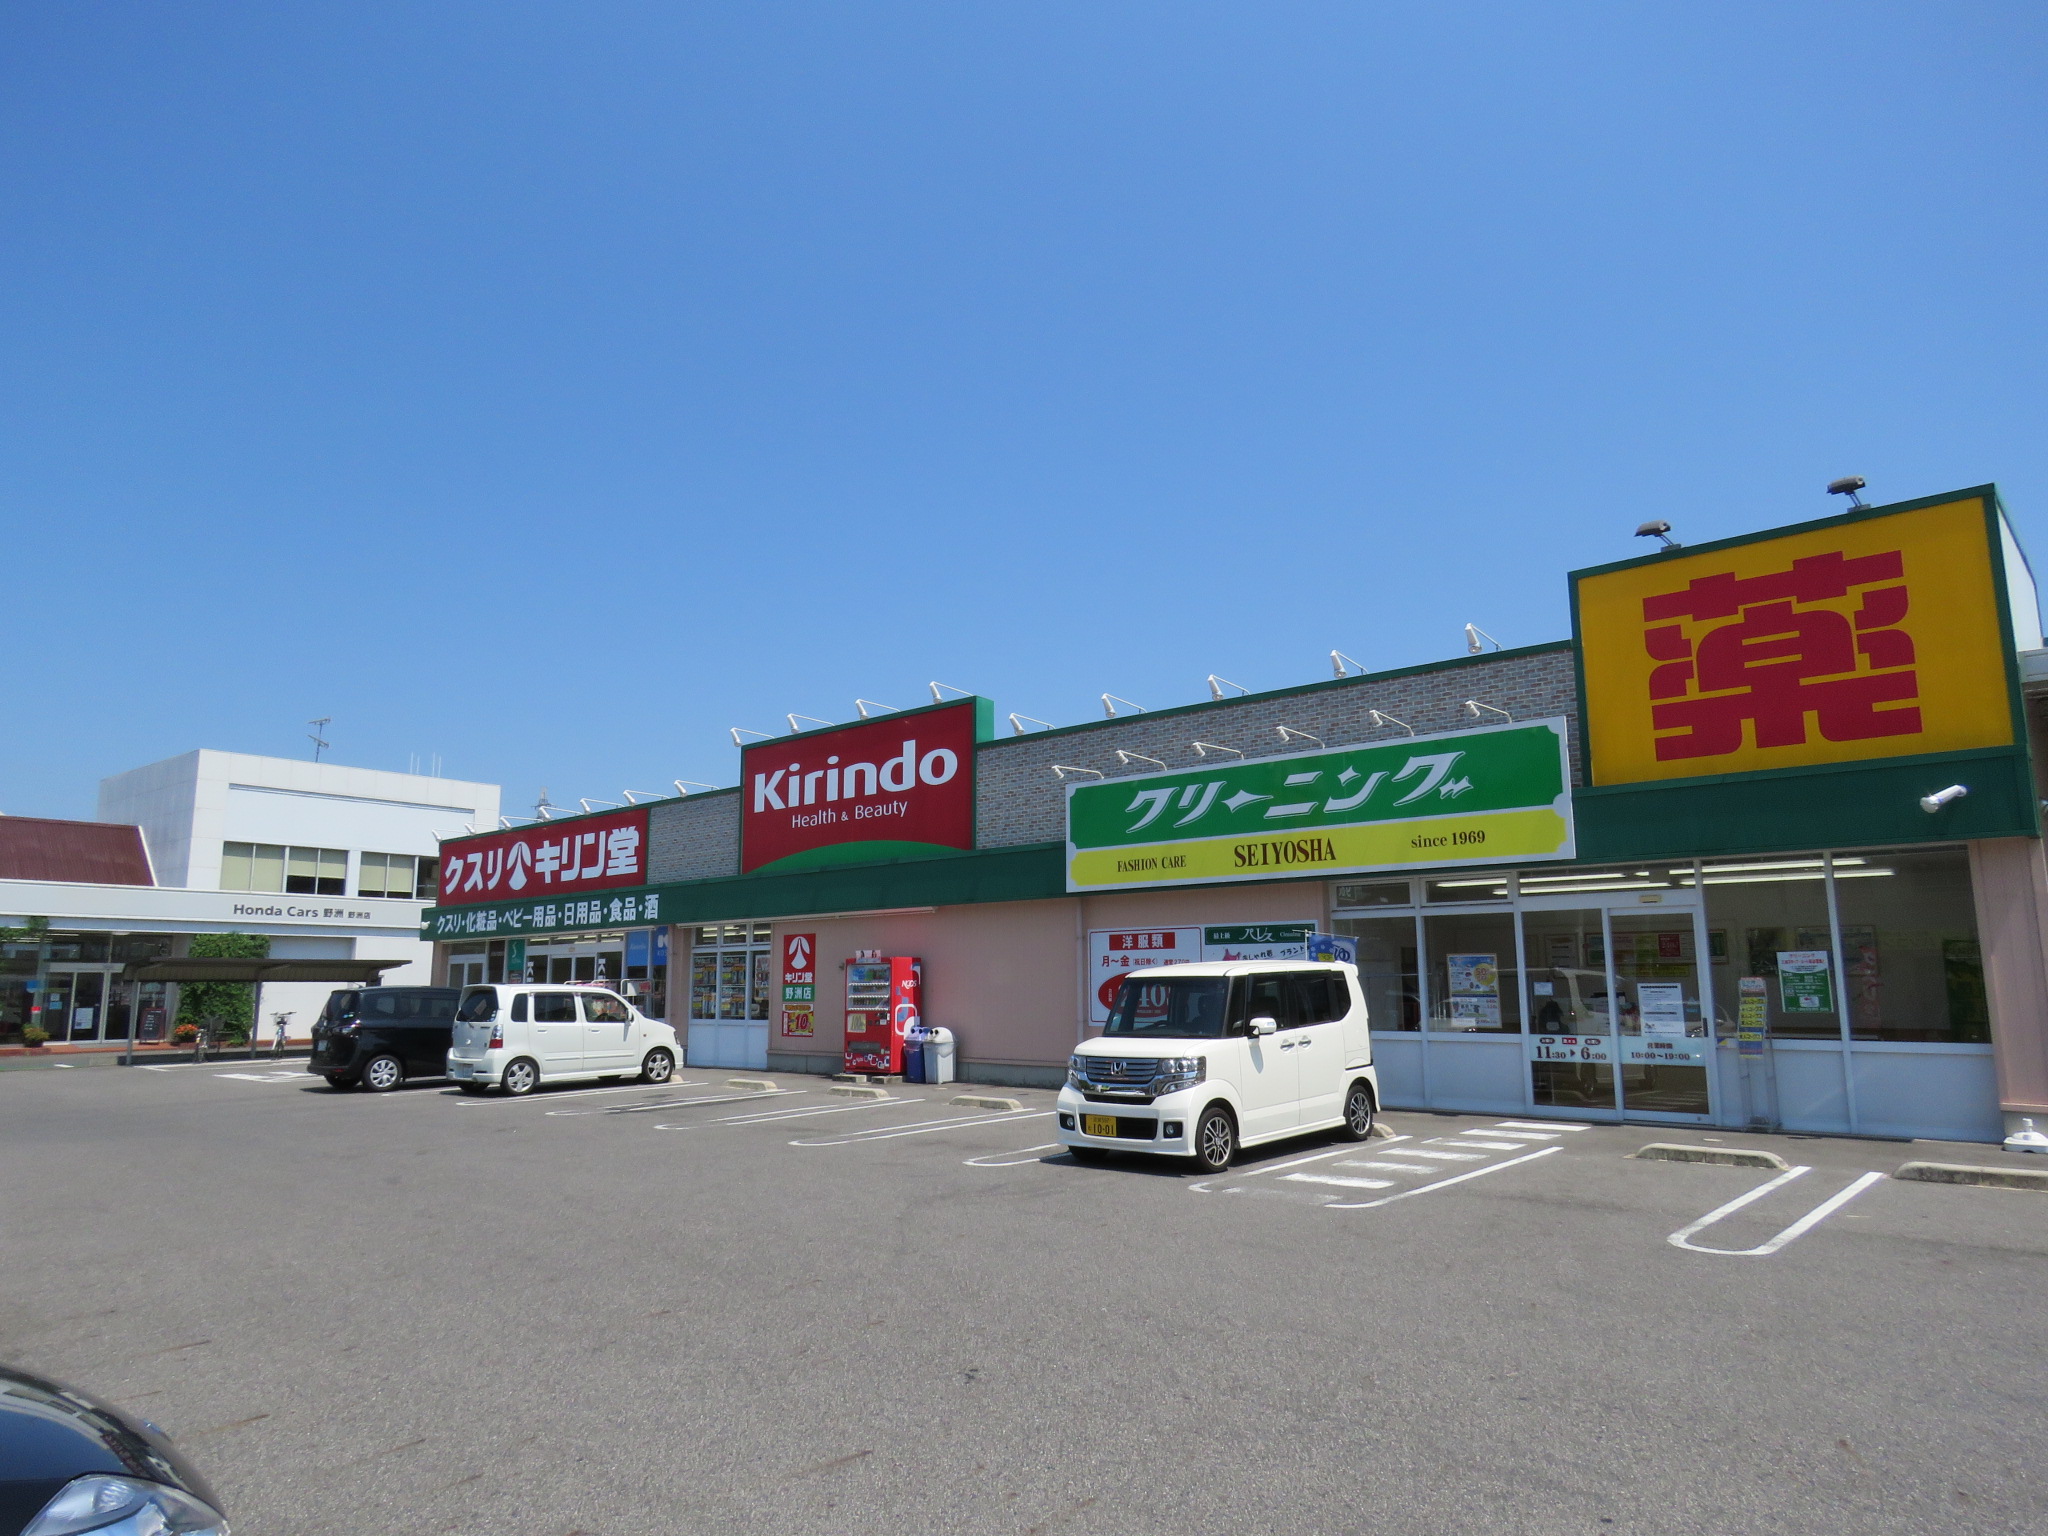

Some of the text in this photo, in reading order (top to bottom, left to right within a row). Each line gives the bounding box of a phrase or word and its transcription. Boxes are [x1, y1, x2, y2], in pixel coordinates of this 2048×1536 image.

[1642, 550, 1923, 762] 薬
[754, 739, 958, 813] Kirindo
[1124, 751, 1474, 834] クリーニング
[792, 801, 908, 828] Health & Beauty
[1411, 830, 1486, 849] since 1969
[444, 826, 640, 895] クスリ キリン堂
[1233, 837, 1337, 868] SEIYOSHA
[1117, 855, 1187, 873] FASHION CARE
[233, 904, 283, 916] Honda
[287, 906, 319, 918] Cars
[323, 908, 344, 918] 野洲
[1122, 934, 1164, 949] 洋服類
[1239, 927, 1276, 943] パレス
[785, 971, 813, 983] キリン堂
[785, 986, 812, 1000] 野洲店
[1535, 1046, 1607, 1060] 11:30 6:00
